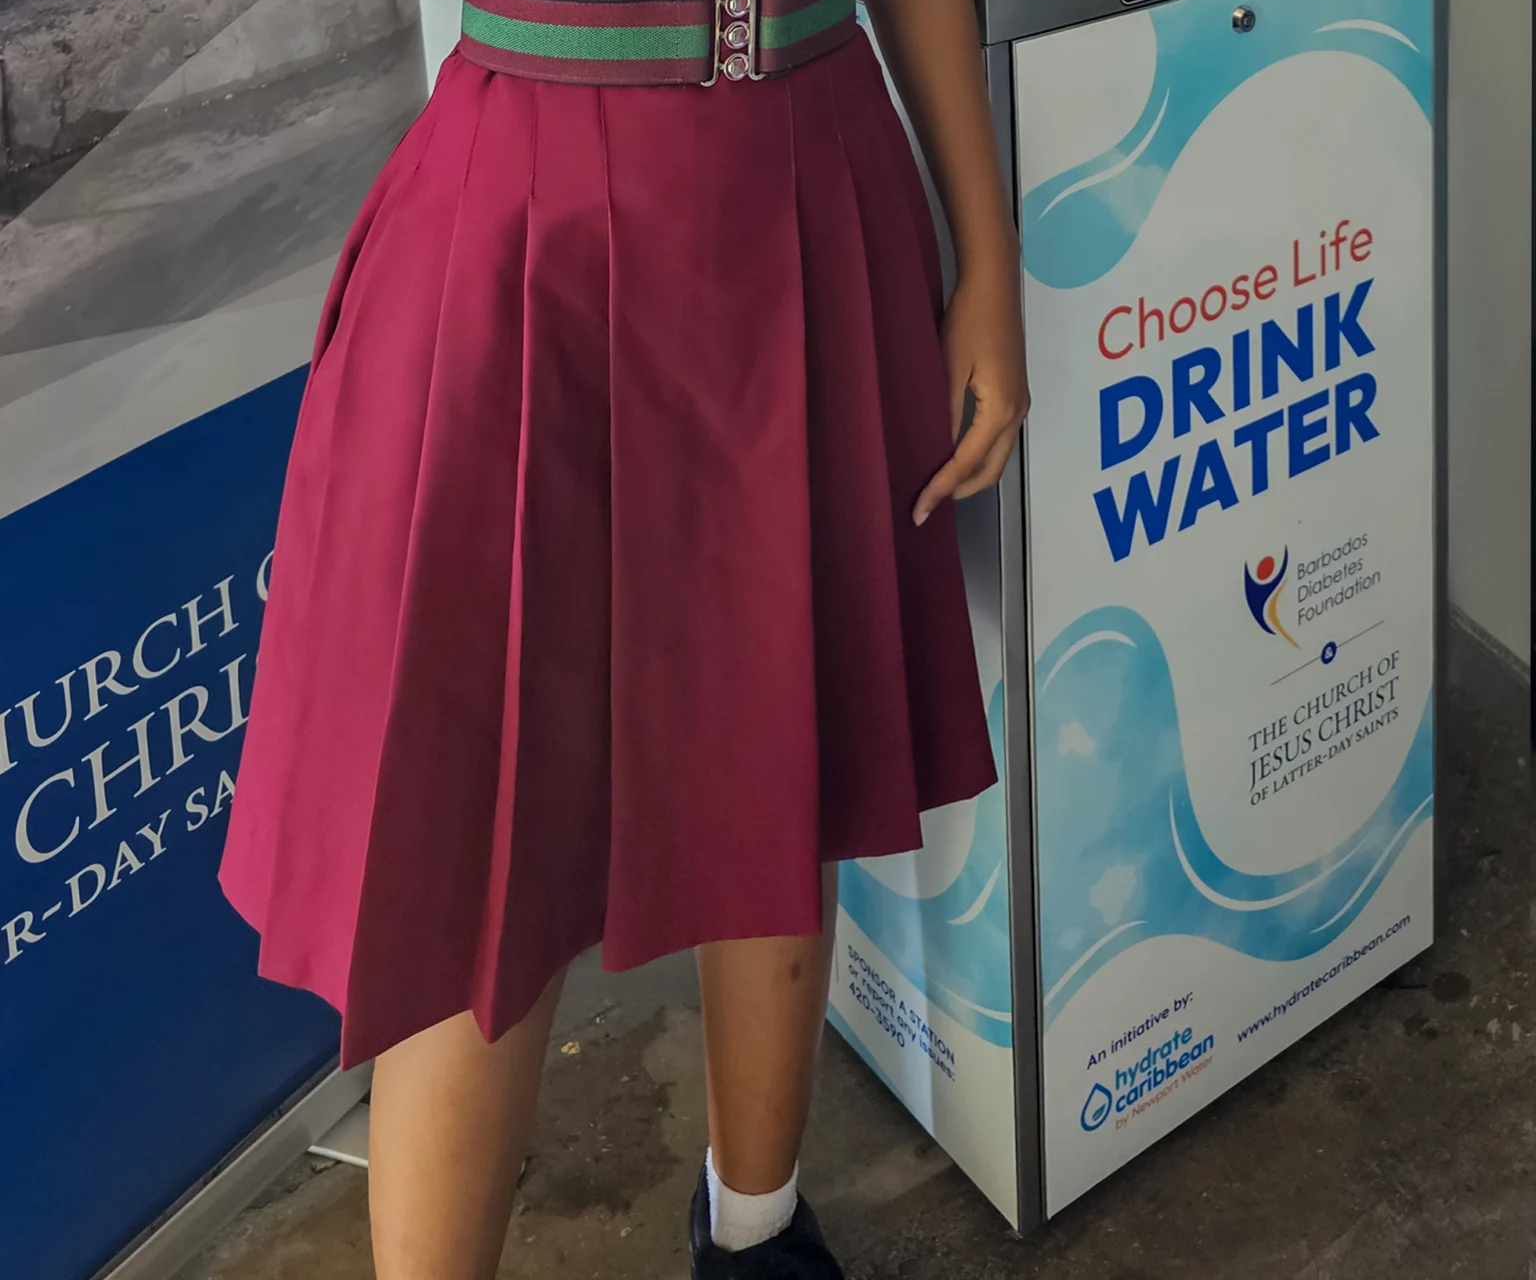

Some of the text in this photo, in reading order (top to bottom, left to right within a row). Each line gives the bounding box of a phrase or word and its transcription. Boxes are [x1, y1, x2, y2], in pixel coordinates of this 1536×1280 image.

[1097, 219, 1374, 361] Choose Life
[1099, 277, 1377, 471] DRINK
[1092, 372, 1381, 564] WATER
[1297, 533, 1368, 580] Barbados
[1297, 557, 1364, 603] Diabetes
[1297, 571, 1381, 626] Foundation
[1248, 649, 1400, 752] THE CHURCH OF
[1249, 676, 1399, 792] JESUS CHRIST
[15, 653, 250, 863] CHRI
[1250, 706, 1399, 806] OF LATTER-DAY SAINTS
[1, 770, 236, 965] R-DAY SA
[848, 964, 859, 979] or
[862, 977, 895, 1018] report
[897, 1015, 917, 1042] any
[848, 944, 955, 1066] SPONSOR A STATION
[849, 982, 905, 1048] 420-3590
[1236, 914, 1412, 1042] www.hydratecaribbean.com
[1087, 991, 1194, 1071] An initiative by:
[1115, 1027, 1193, 1091] hydrate
[1115, 1034, 1214, 1113] caribbean
[1115, 1114, 1129, 1131] by
[1131, 1079, 1179, 1119] Newport
